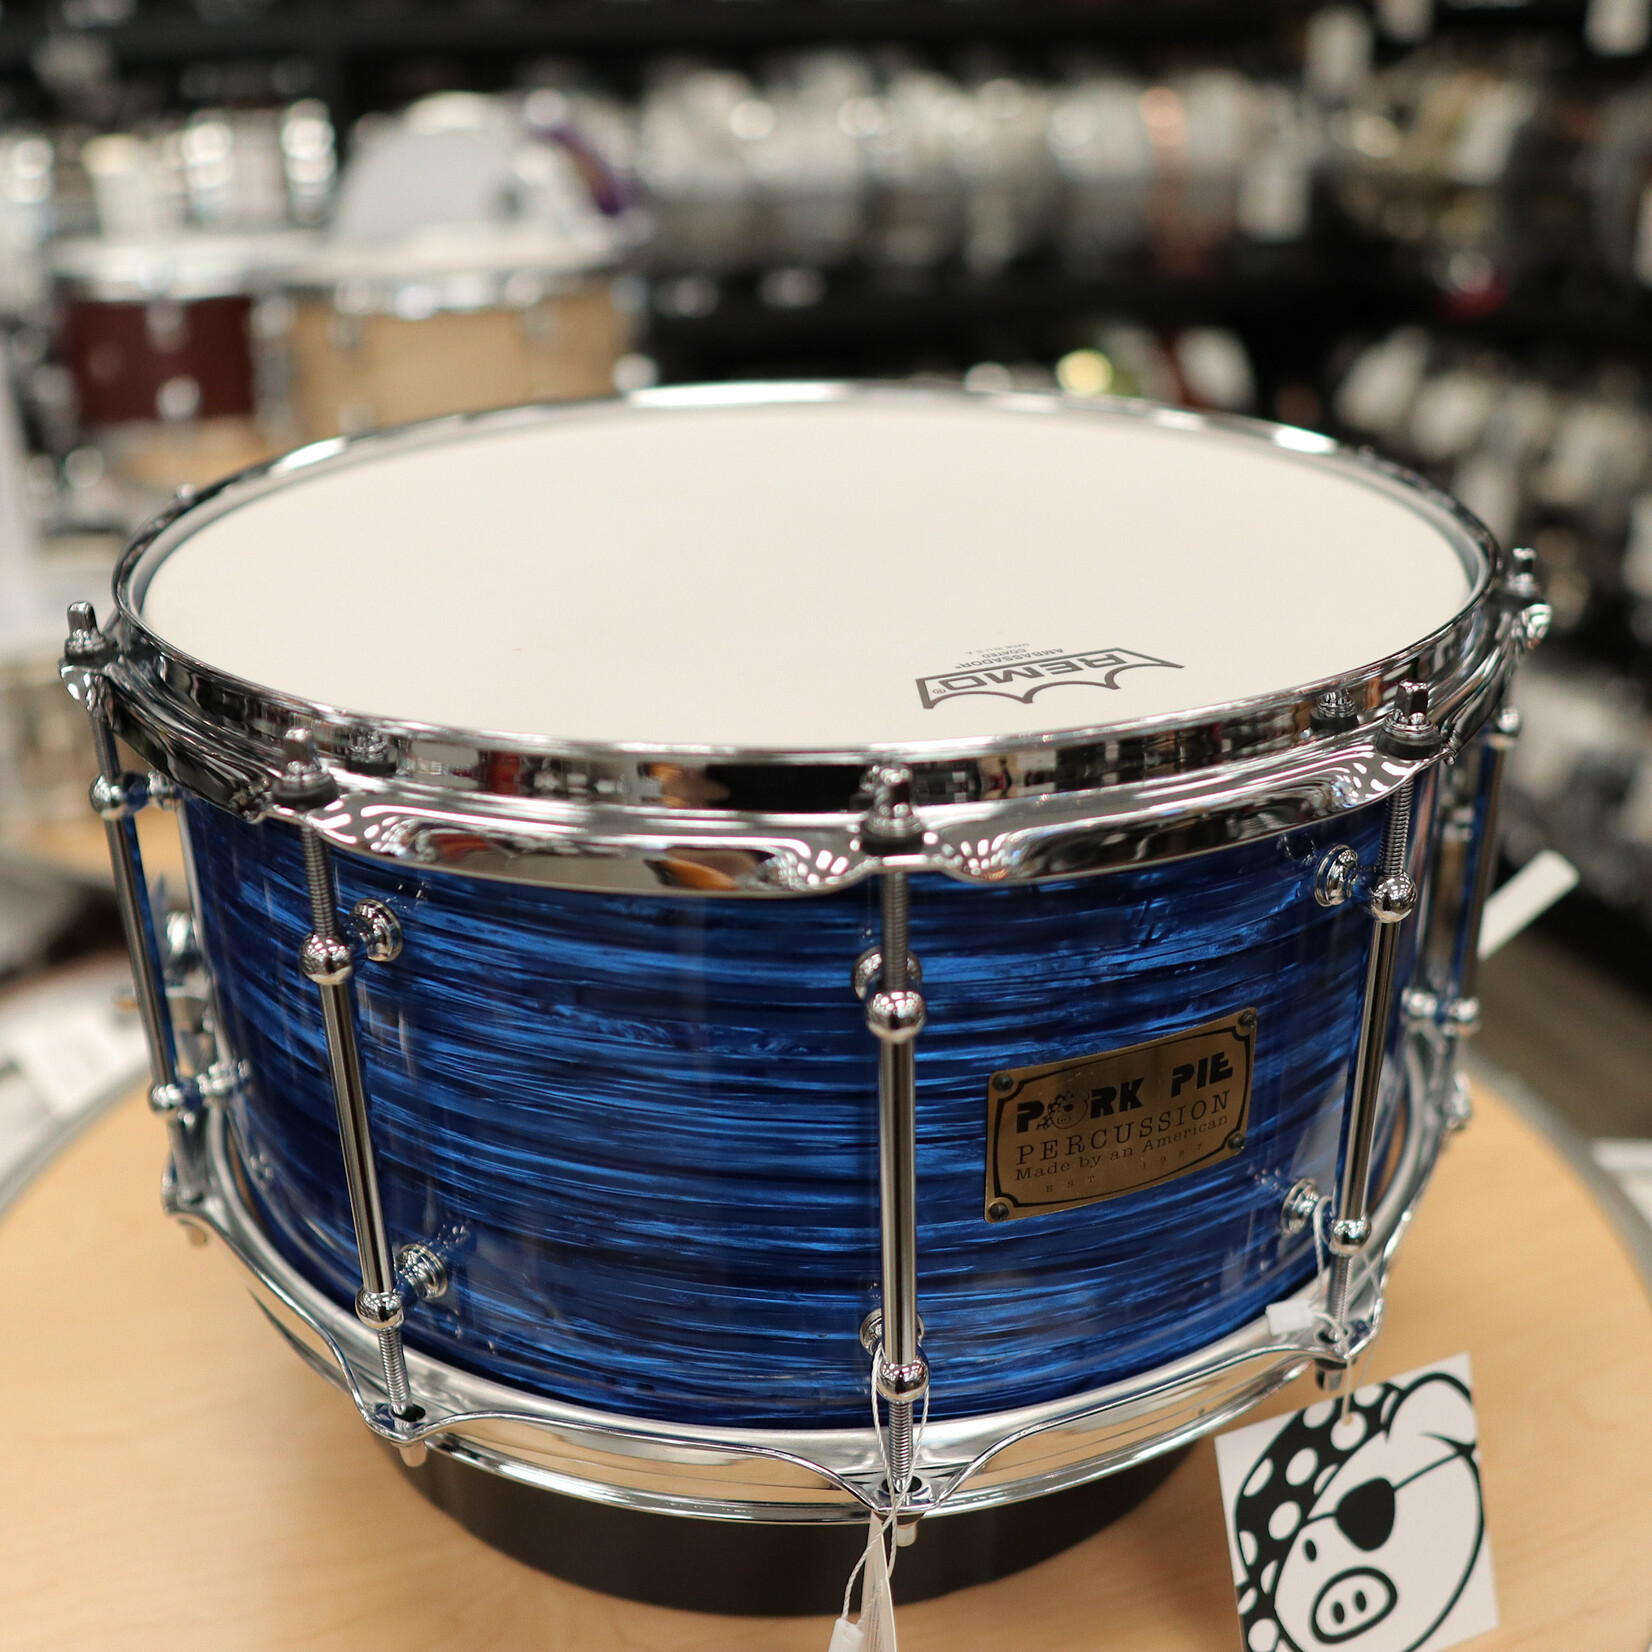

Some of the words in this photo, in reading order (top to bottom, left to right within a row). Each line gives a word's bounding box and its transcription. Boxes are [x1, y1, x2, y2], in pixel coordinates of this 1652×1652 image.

[938, 652, 1128, 691] REMO
[981, 648, 1027, 659] COATED
[1170, 1050, 1234, 1098] PIE
[1015, 1089, 1231, 1166] PERCUSSION
[1016, 1161, 1070, 1182] Made
[1079, 1155, 1101, 1169] by
[1109, 1146, 1134, 1160] an
[1142, 1115, 1228, 1153] American
